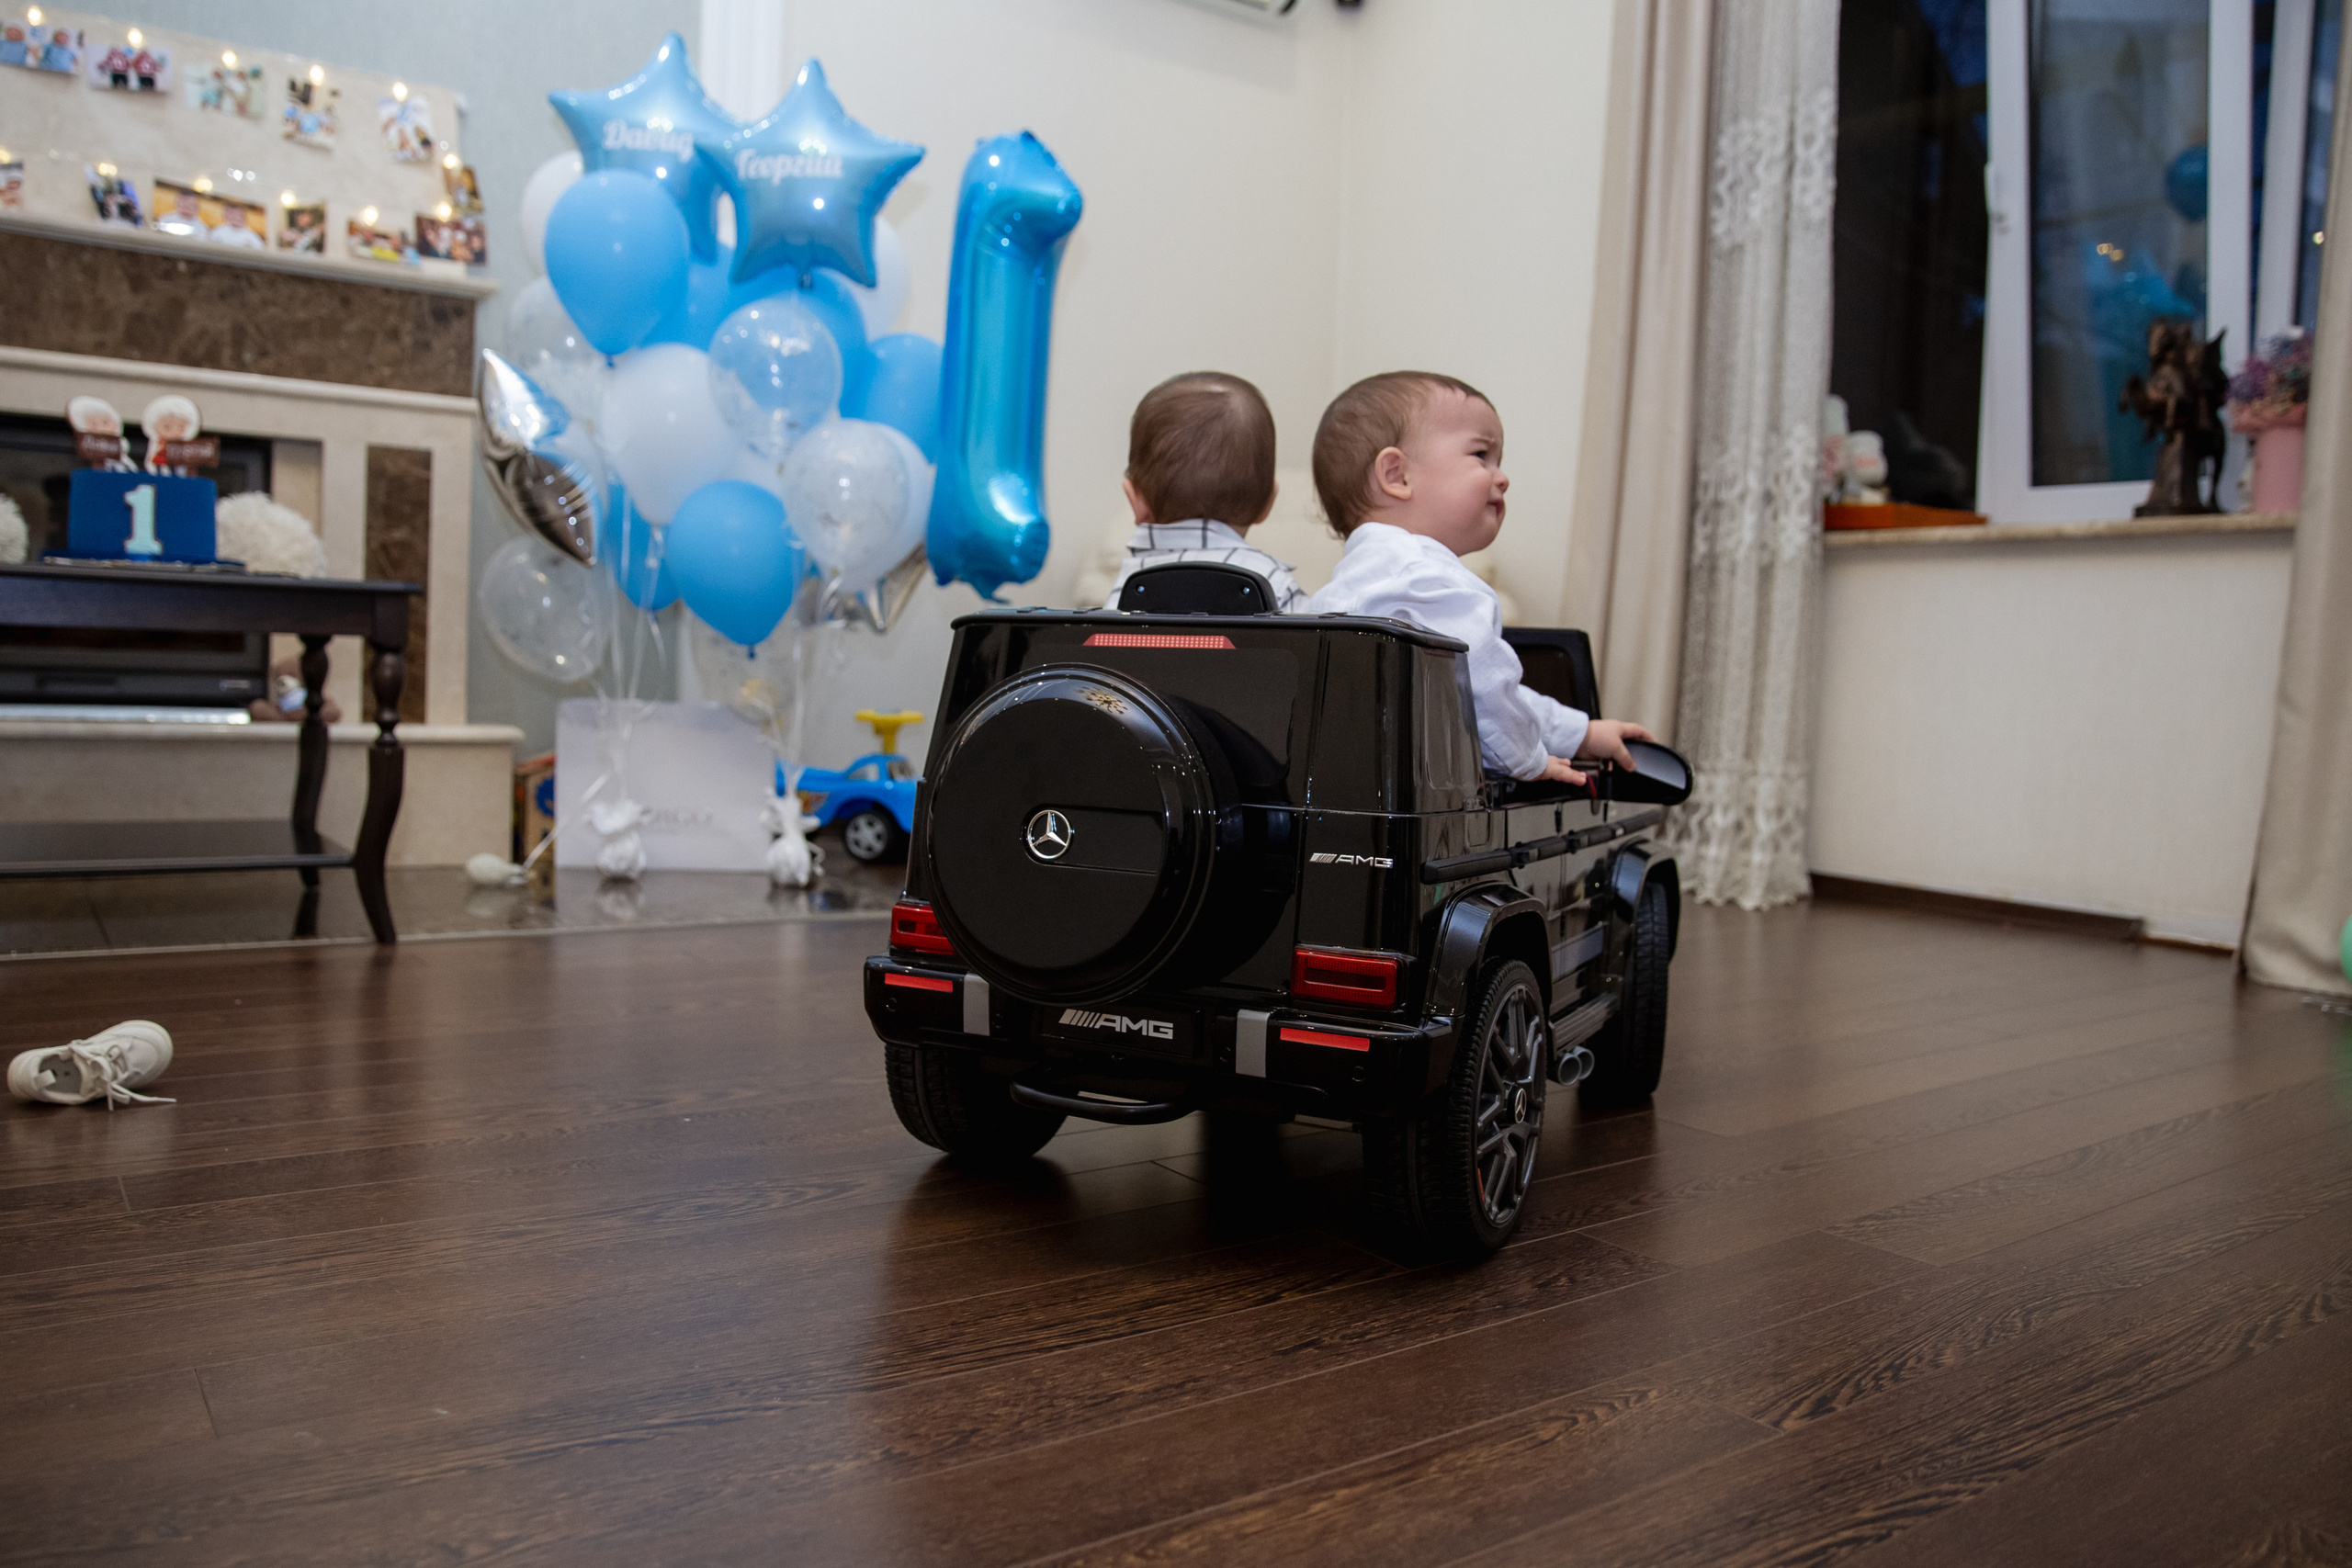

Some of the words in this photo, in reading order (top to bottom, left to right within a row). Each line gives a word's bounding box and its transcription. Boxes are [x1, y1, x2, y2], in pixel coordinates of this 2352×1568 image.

[123, 483, 164, 555] 1
[1334, 854, 1394, 869] AMG
[1093, 1013, 1173, 1040] AMG
